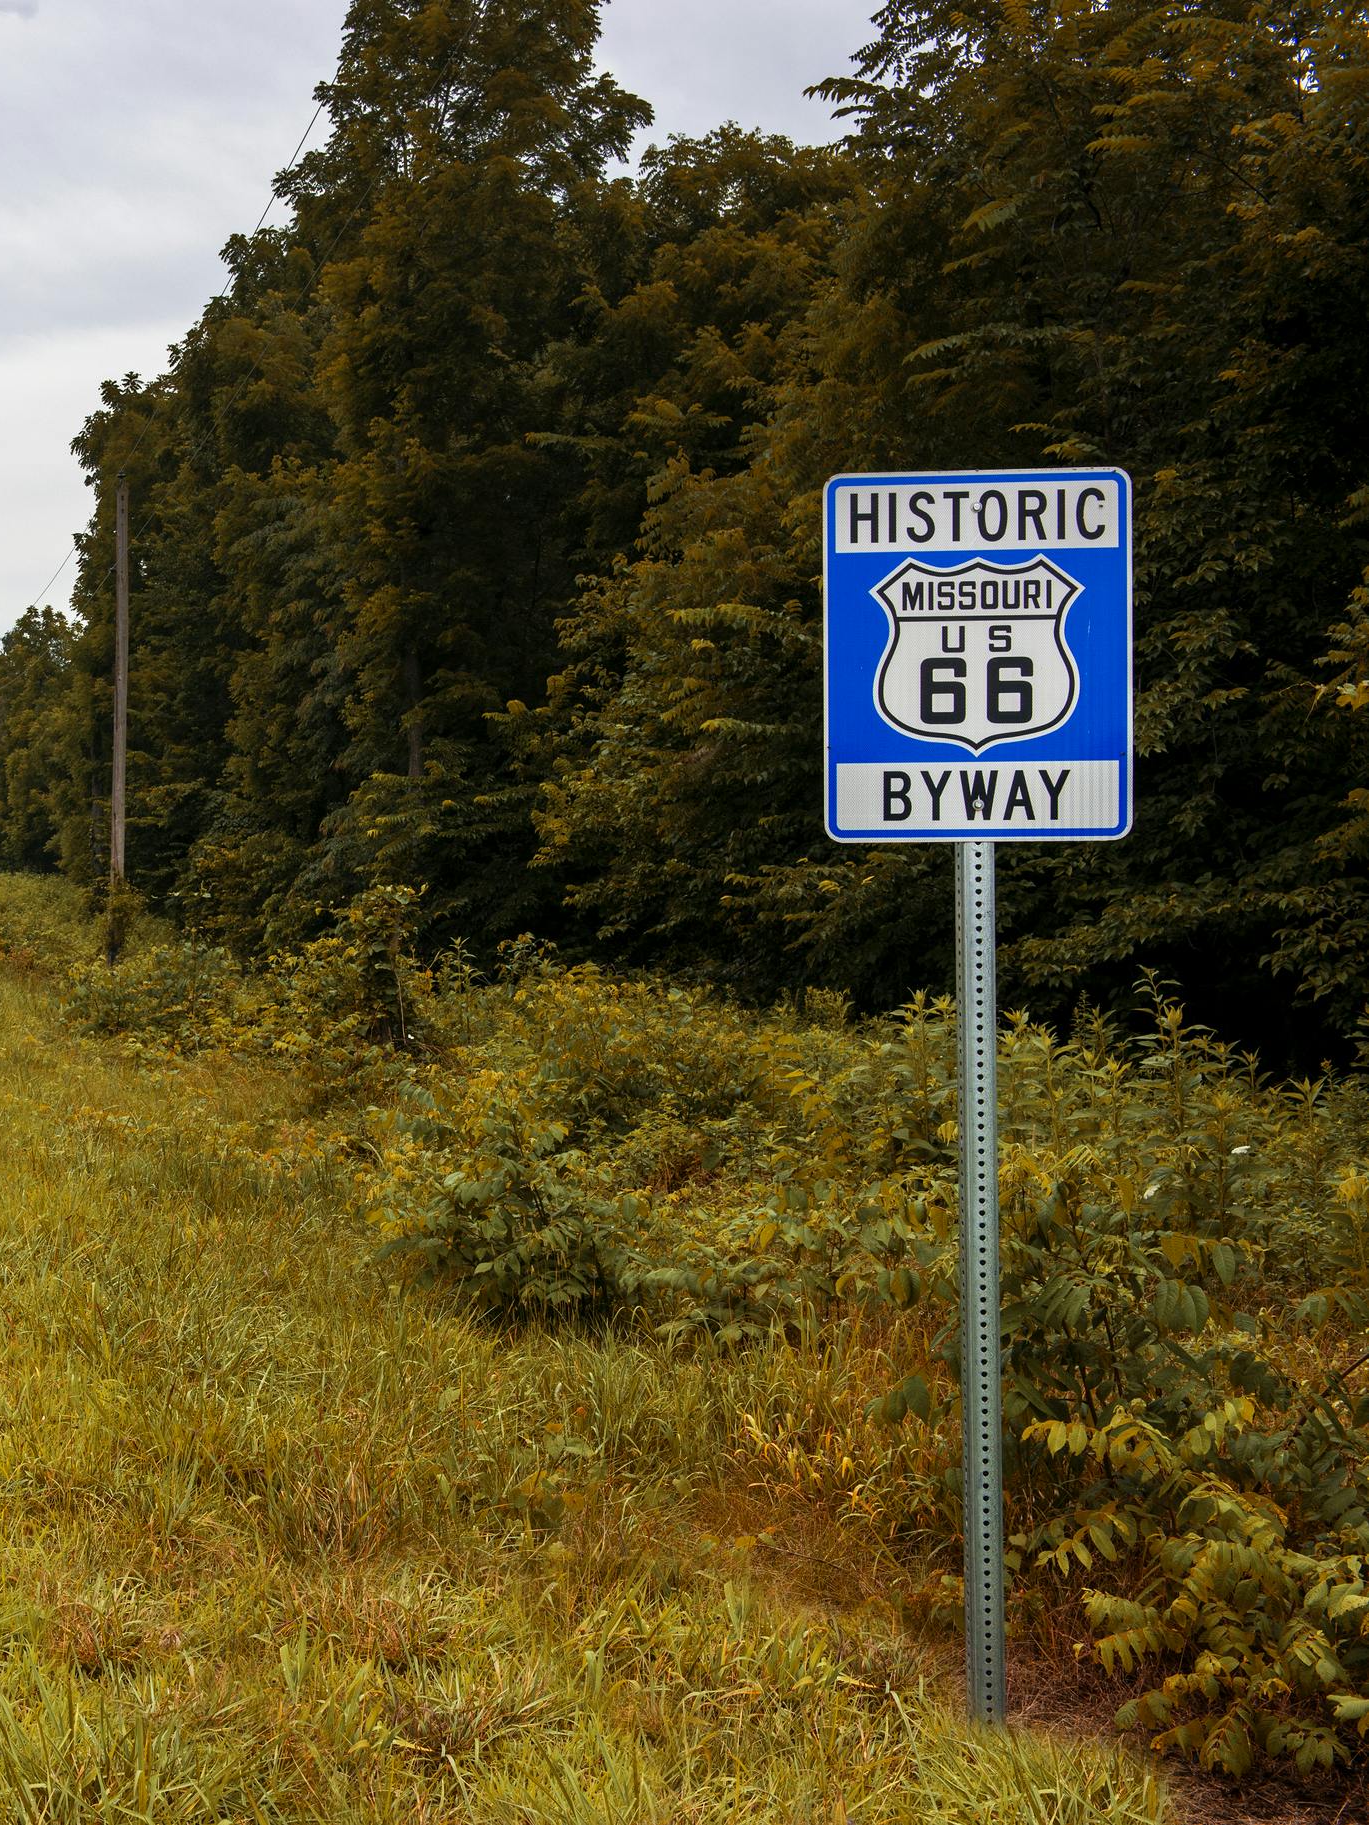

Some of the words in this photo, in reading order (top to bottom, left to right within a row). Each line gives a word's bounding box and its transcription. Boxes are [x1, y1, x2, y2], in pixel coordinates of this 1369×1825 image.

[849, 487, 1106, 544] HISTORIC
[902, 579, 1052, 611] MISSOURI
[920, 656, 1034, 725] 66
[883, 769, 1071, 822] BYWAY
